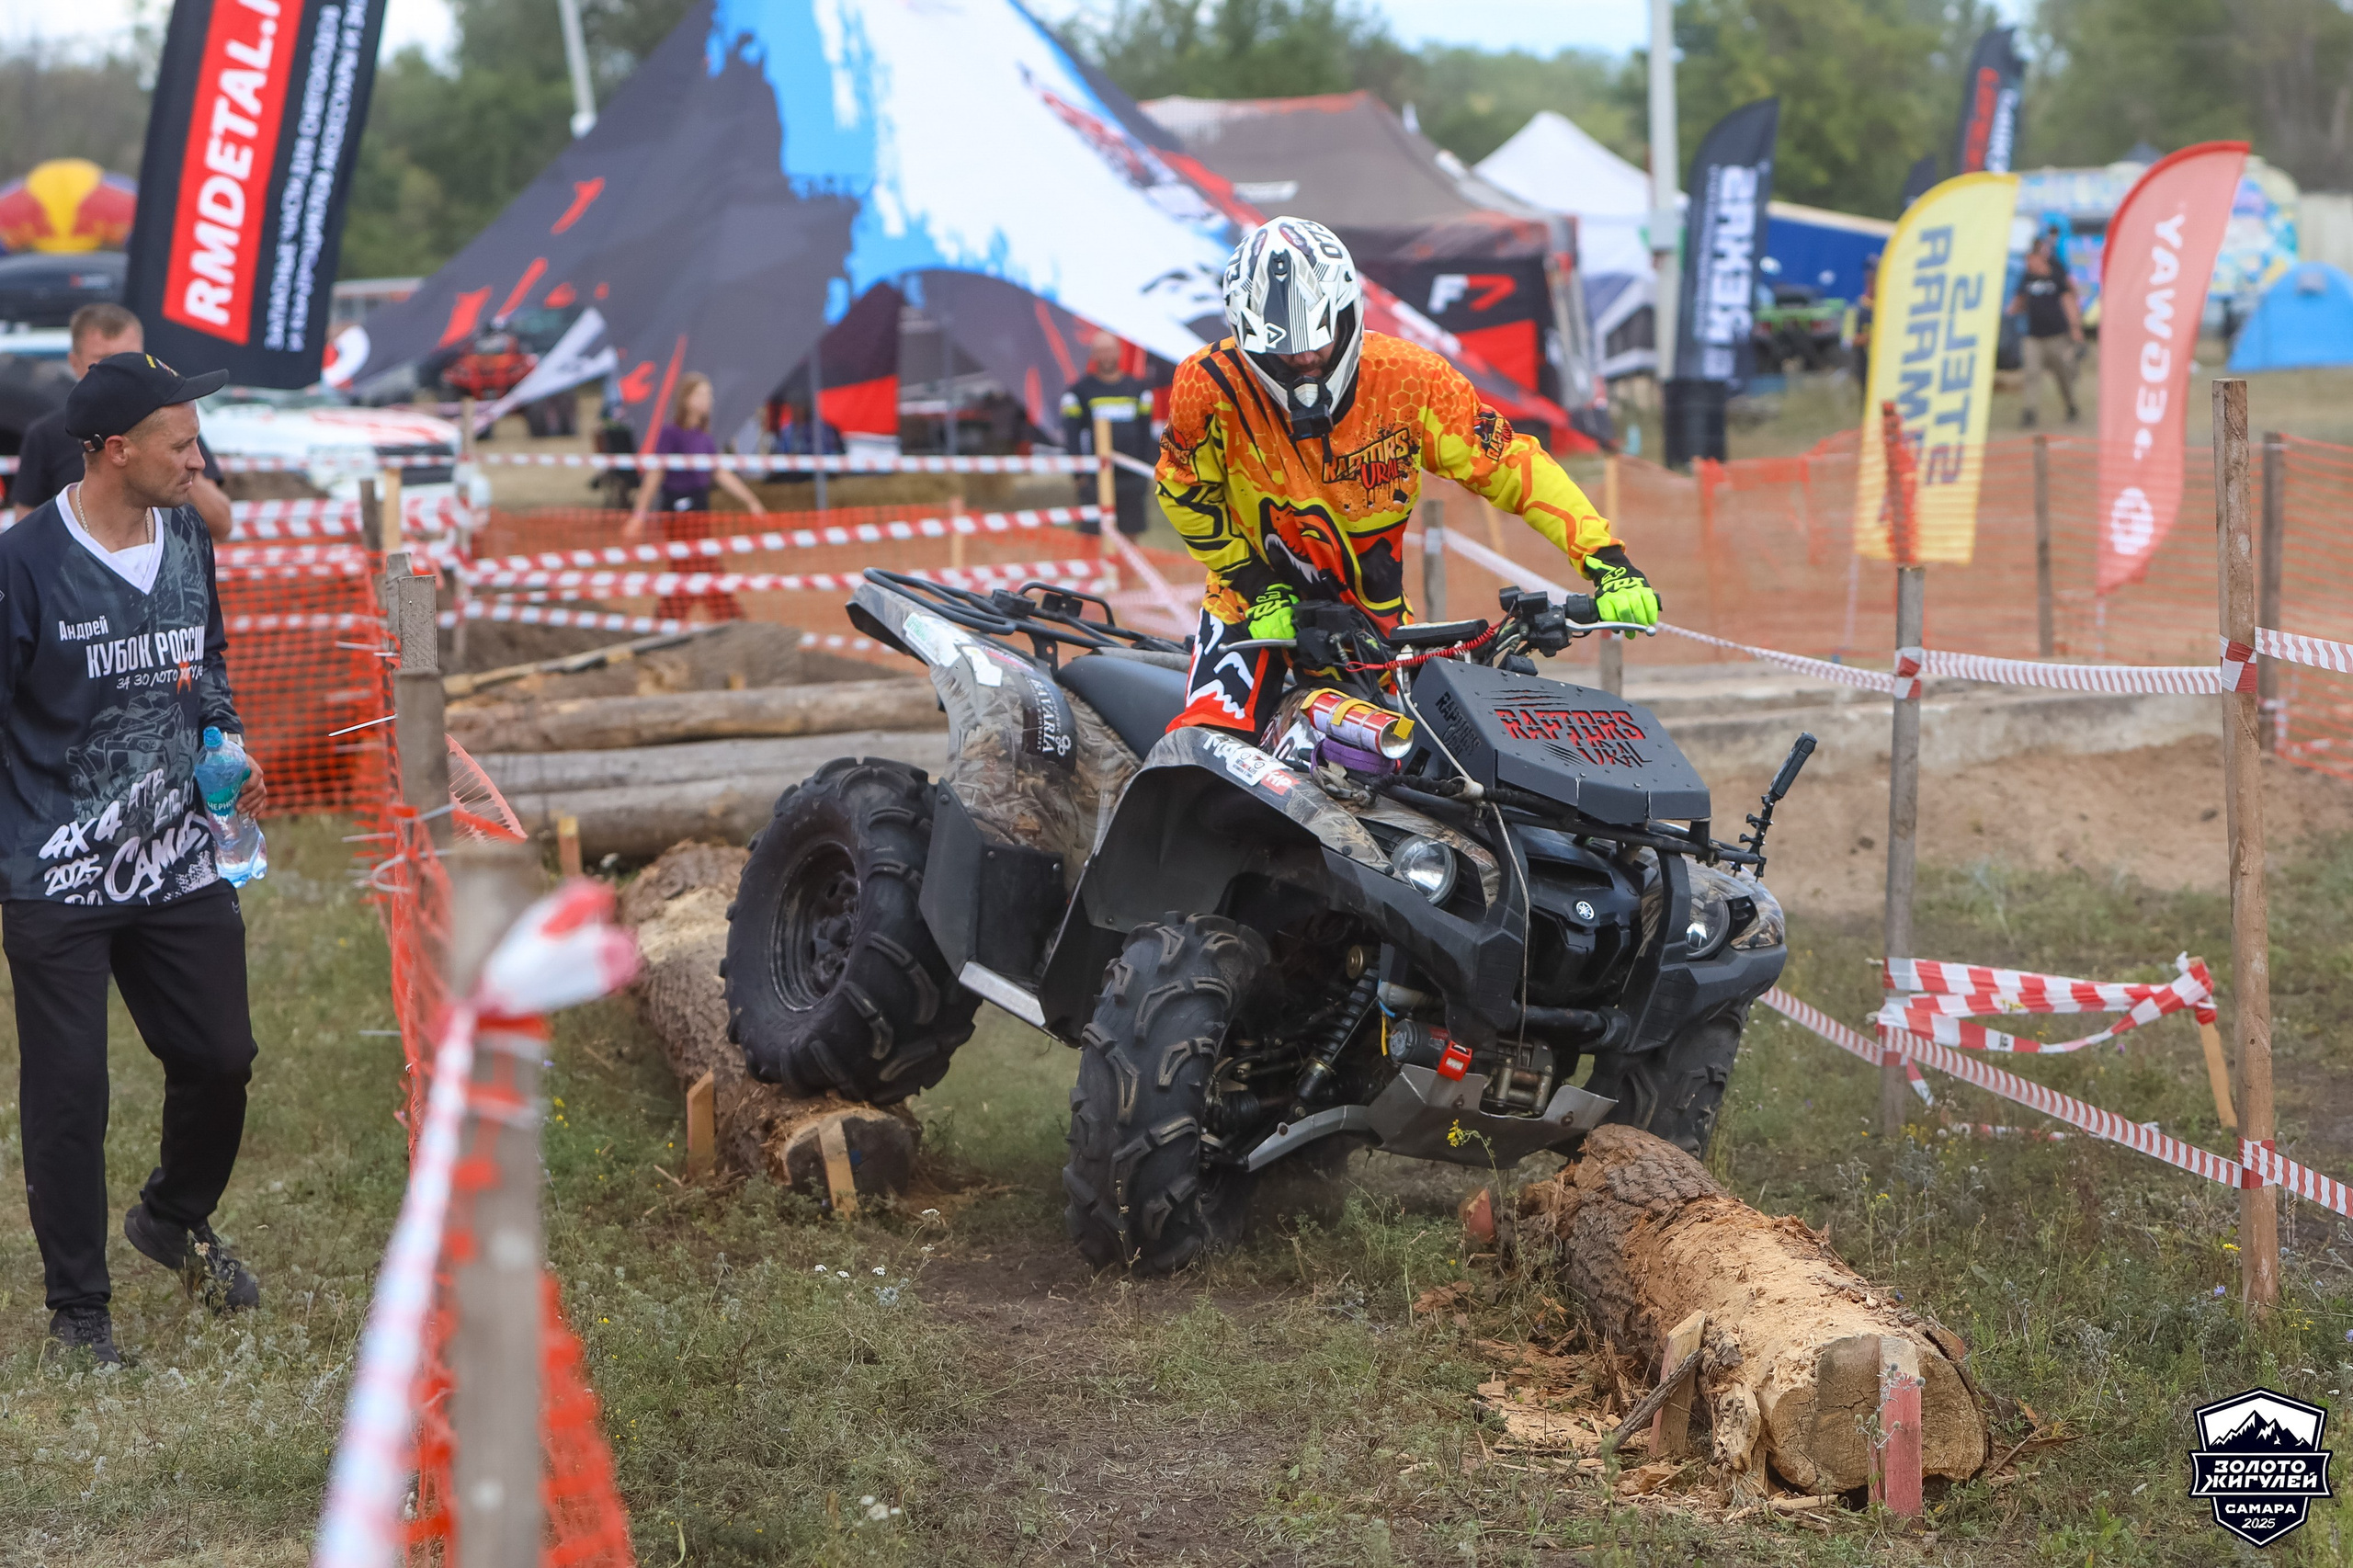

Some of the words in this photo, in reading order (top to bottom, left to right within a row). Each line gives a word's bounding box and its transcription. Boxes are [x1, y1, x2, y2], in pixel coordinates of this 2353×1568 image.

[1323, 428, 1410, 483] RAPTORS
[1361, 459, 1403, 489] URAL
[58, 615, 109, 642] Андрей
[85, 633, 153, 678] КУБОК
[1494, 708, 1646, 740] RAPTORS
[1576, 739, 1653, 768] URAL
[44, 853, 103, 896] 2025
